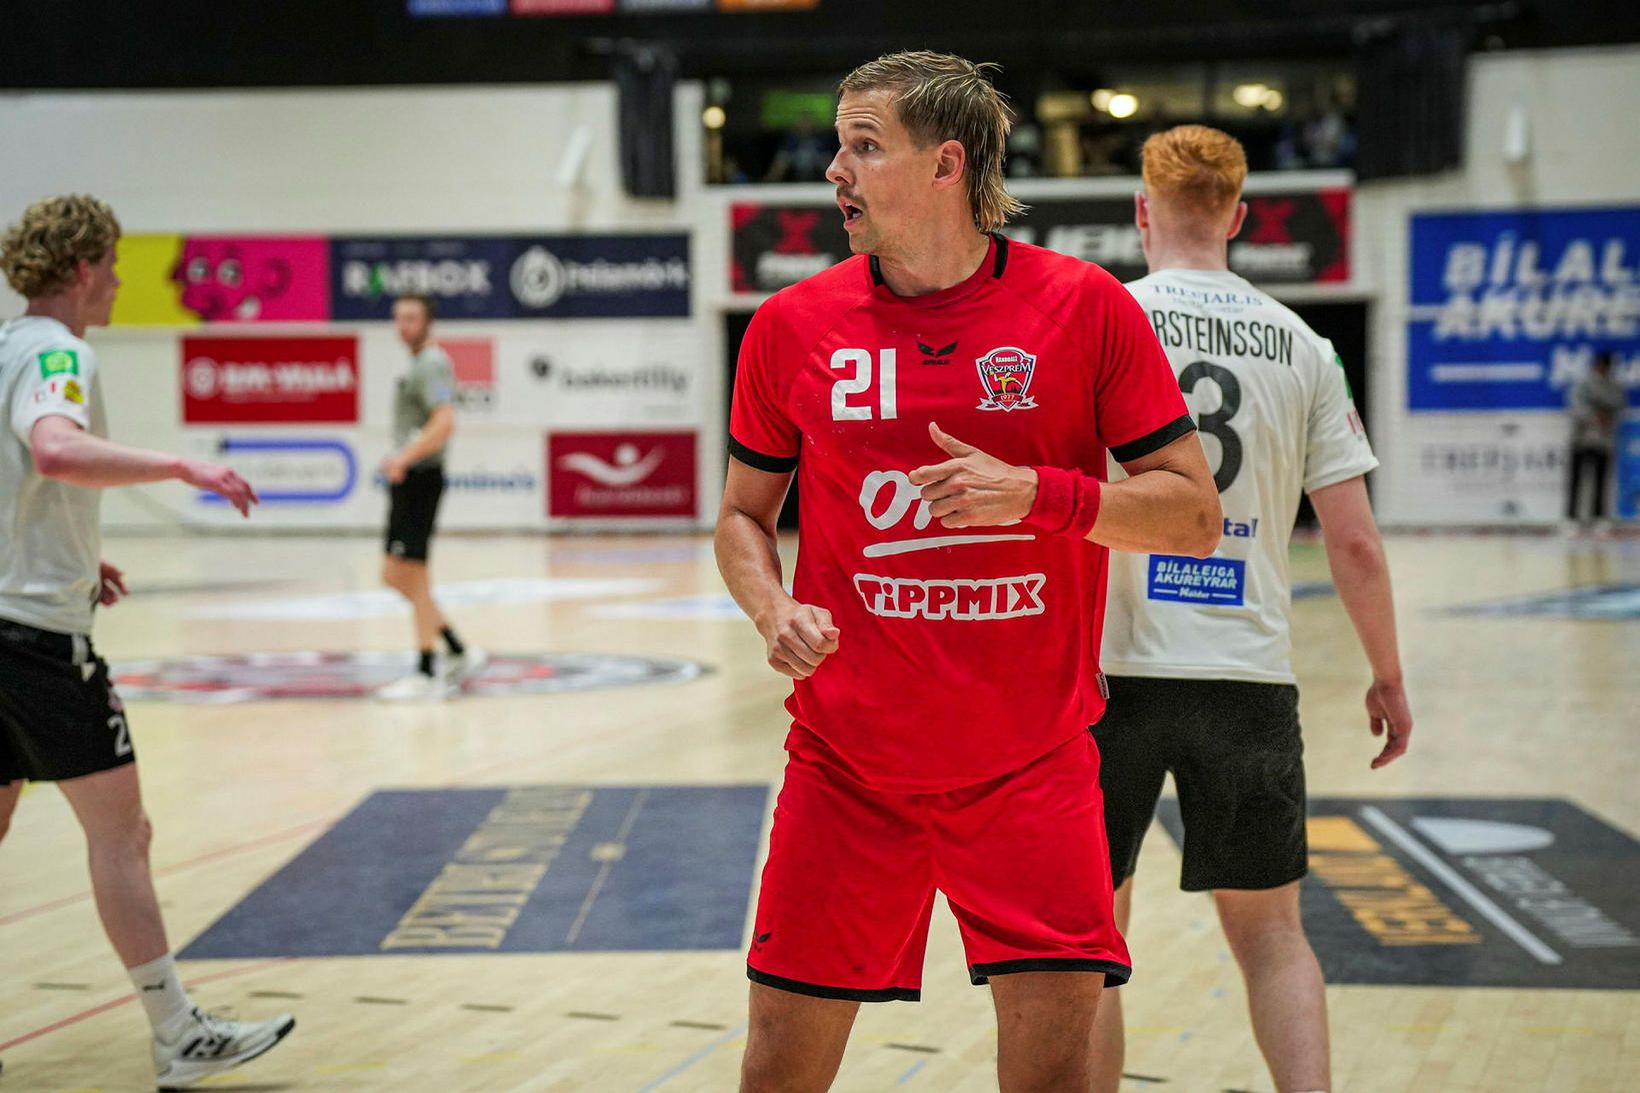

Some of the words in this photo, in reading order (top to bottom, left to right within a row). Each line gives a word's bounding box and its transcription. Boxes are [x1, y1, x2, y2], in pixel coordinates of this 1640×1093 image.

[1444, 230, 1640, 287] BÍLAL
[1147, 309, 1293, 366] RSTEINSSON
[1434, 285, 1640, 339] AKURE
[830, 348, 897, 421] 21
[1222, 517, 1258, 538] tal
[1154, 572, 1238, 589] AKUREYRAR
[1156, 560, 1235, 578] BÍLALEIGA
